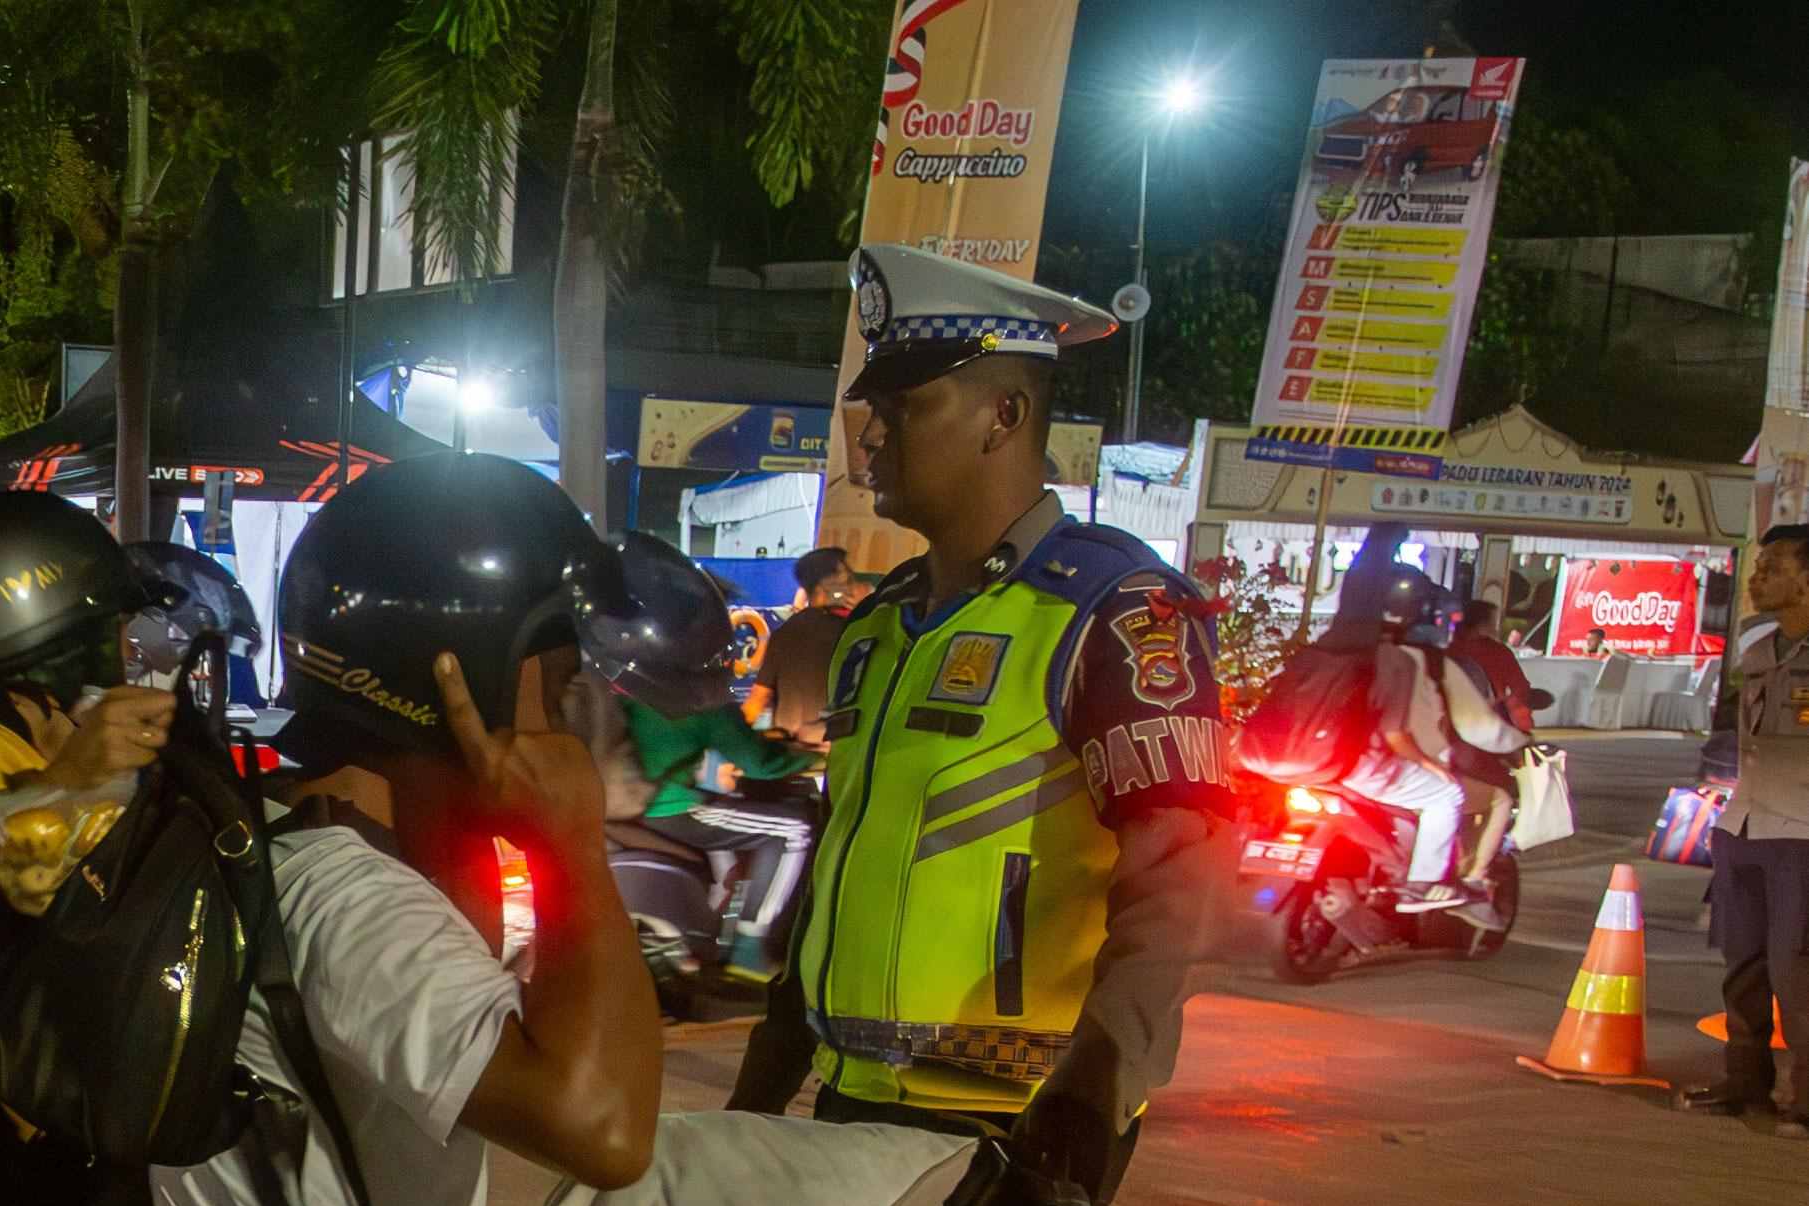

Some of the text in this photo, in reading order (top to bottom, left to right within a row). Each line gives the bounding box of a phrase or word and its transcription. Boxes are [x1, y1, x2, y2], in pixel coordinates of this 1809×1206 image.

[902, 100, 1034, 145] Good Day
[894, 147, 1027, 184] Cappuccino
[1358, 191, 1407, 222] TIPS
[1308, 260, 1327, 276] M
[1306, 291, 1317, 305] S
[1297, 321, 1312, 335] A
[1548, 472, 1596, 490] TAHUN
[1592, 591, 1643, 625] Good
[1641, 592, 1681, 632] Day
[340, 668, 438, 725] Classic
